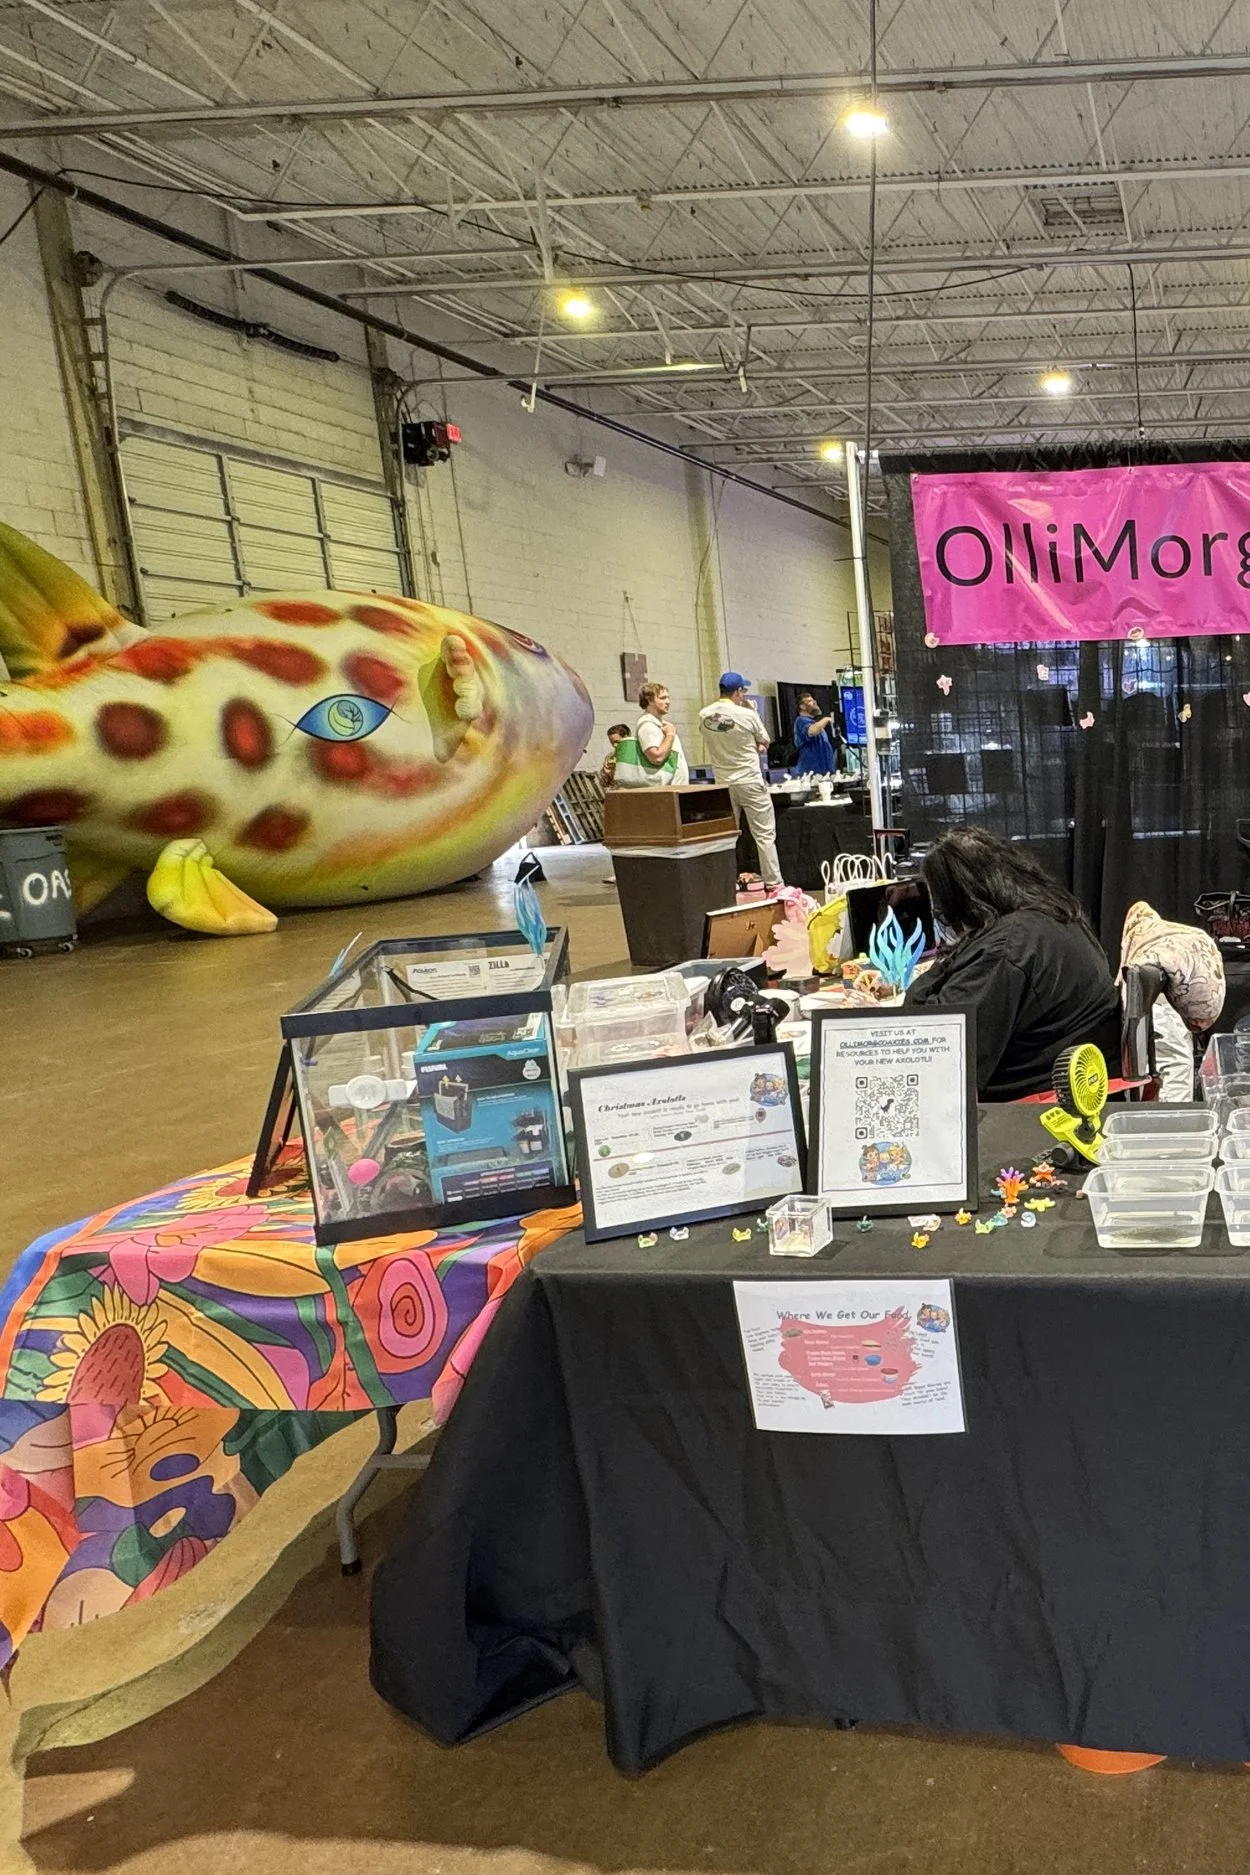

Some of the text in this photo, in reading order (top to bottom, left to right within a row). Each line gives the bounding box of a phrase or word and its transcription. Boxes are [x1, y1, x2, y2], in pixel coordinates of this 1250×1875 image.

[488, 960, 510, 969] ZILLA
[836, 1050, 879, 1058] RESOURCES
[598, 1102, 645, 1112] Christmas
[776, 1310, 811, 1320] Where
[815, 1310, 833, 1319] We
[836, 1310, 856, 1319] Get
[860, 1310, 880, 1319] Our
